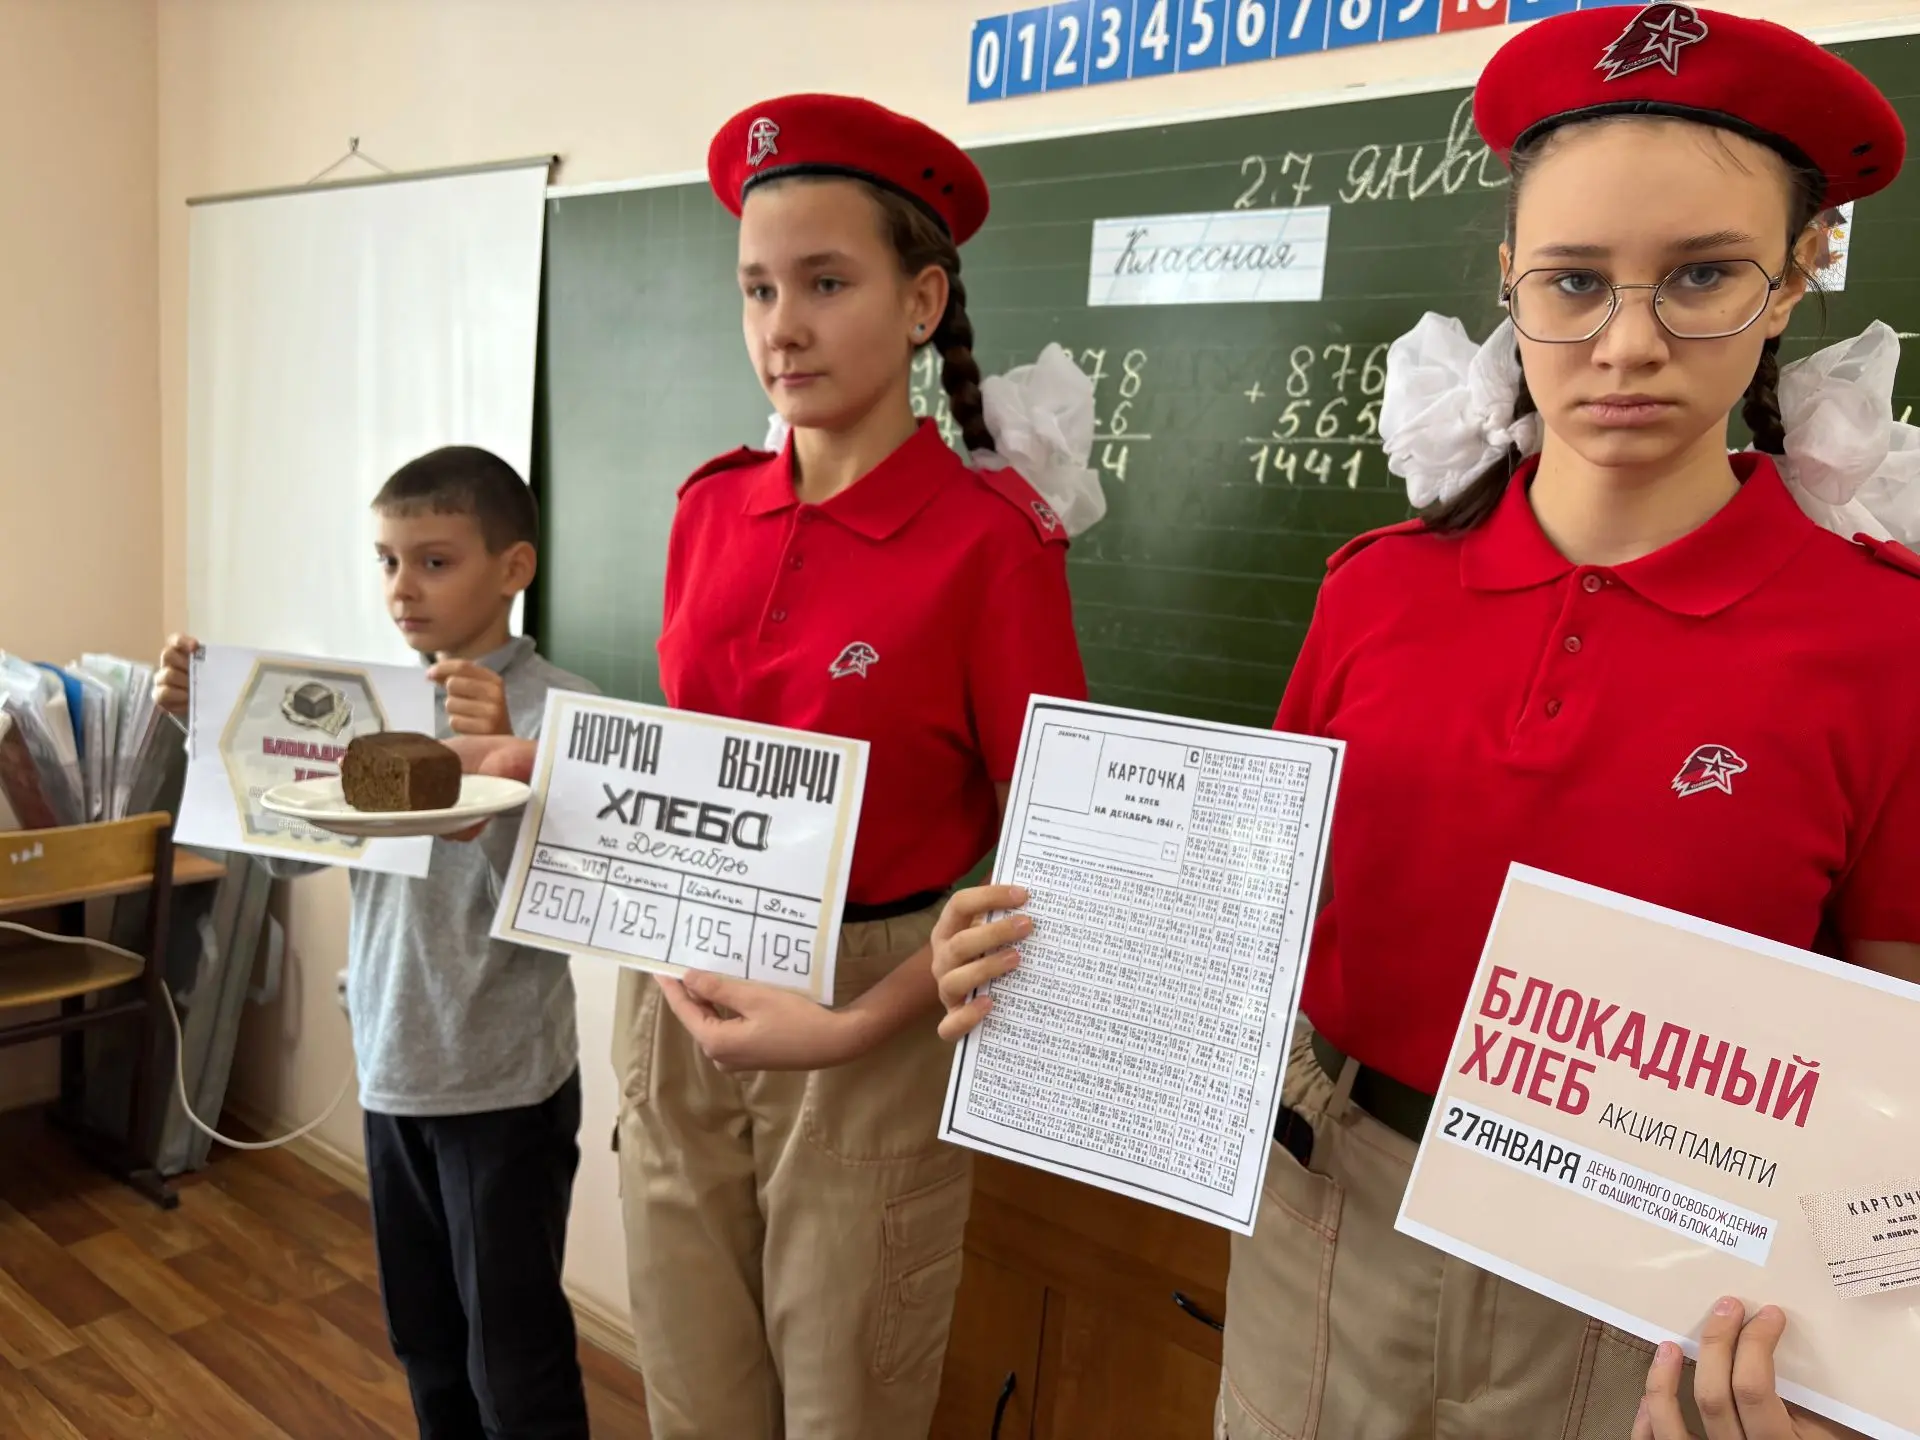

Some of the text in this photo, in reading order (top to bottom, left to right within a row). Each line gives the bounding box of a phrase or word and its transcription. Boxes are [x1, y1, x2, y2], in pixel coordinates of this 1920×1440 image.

[977, 30, 1000, 89] 0
[1018, 23, 1036, 82] 1
[1053, 16, 1080, 76] 2
[1096, 6, 1122, 70] 3
[1140, 0, 1170, 61] 4
[1187, 0, 1215, 56] 5
[1236, 0, 1266, 48] 6
[1113, 228, 1298, 275] Классная
[1062, 347, 1148, 398] 78
[1249, 445, 1364, 489] 1441
[567, 710, 841, 804] НОРМА ВЫДАЧИ
[1107, 761, 1186, 792] КАРТОЧКА
[1094, 805, 1106, 815] НА
[1110, 808, 1153, 824] ДЕКАБРЬ
[1156, 818, 1173, 829] 1941
[1125, 794, 1160, 807] НА ХЛЕБ
[598, 832, 749, 876] на Декабрь
[764, 898, 807, 919] Дети
[761, 931, 811, 976] 125
[1458, 1023, 1597, 1116] ХЛЕБ
[1479, 965, 1821, 1128] БЛОКАДНЫЙ
[1599, 1102, 1778, 1188] АКЦИЯ ПАМЯТИ
[1582, 1176, 1739, 1248] ОТ ФАШИСТСКОЙ БЛОКАДЫ
[1586, 1160, 1768, 1240] ДЕНЬ ПОЛНОГО ОСВОБОЖДЕНИЯ
[1872, 1228, 1919, 1242] НА ЯНВАРЬ
